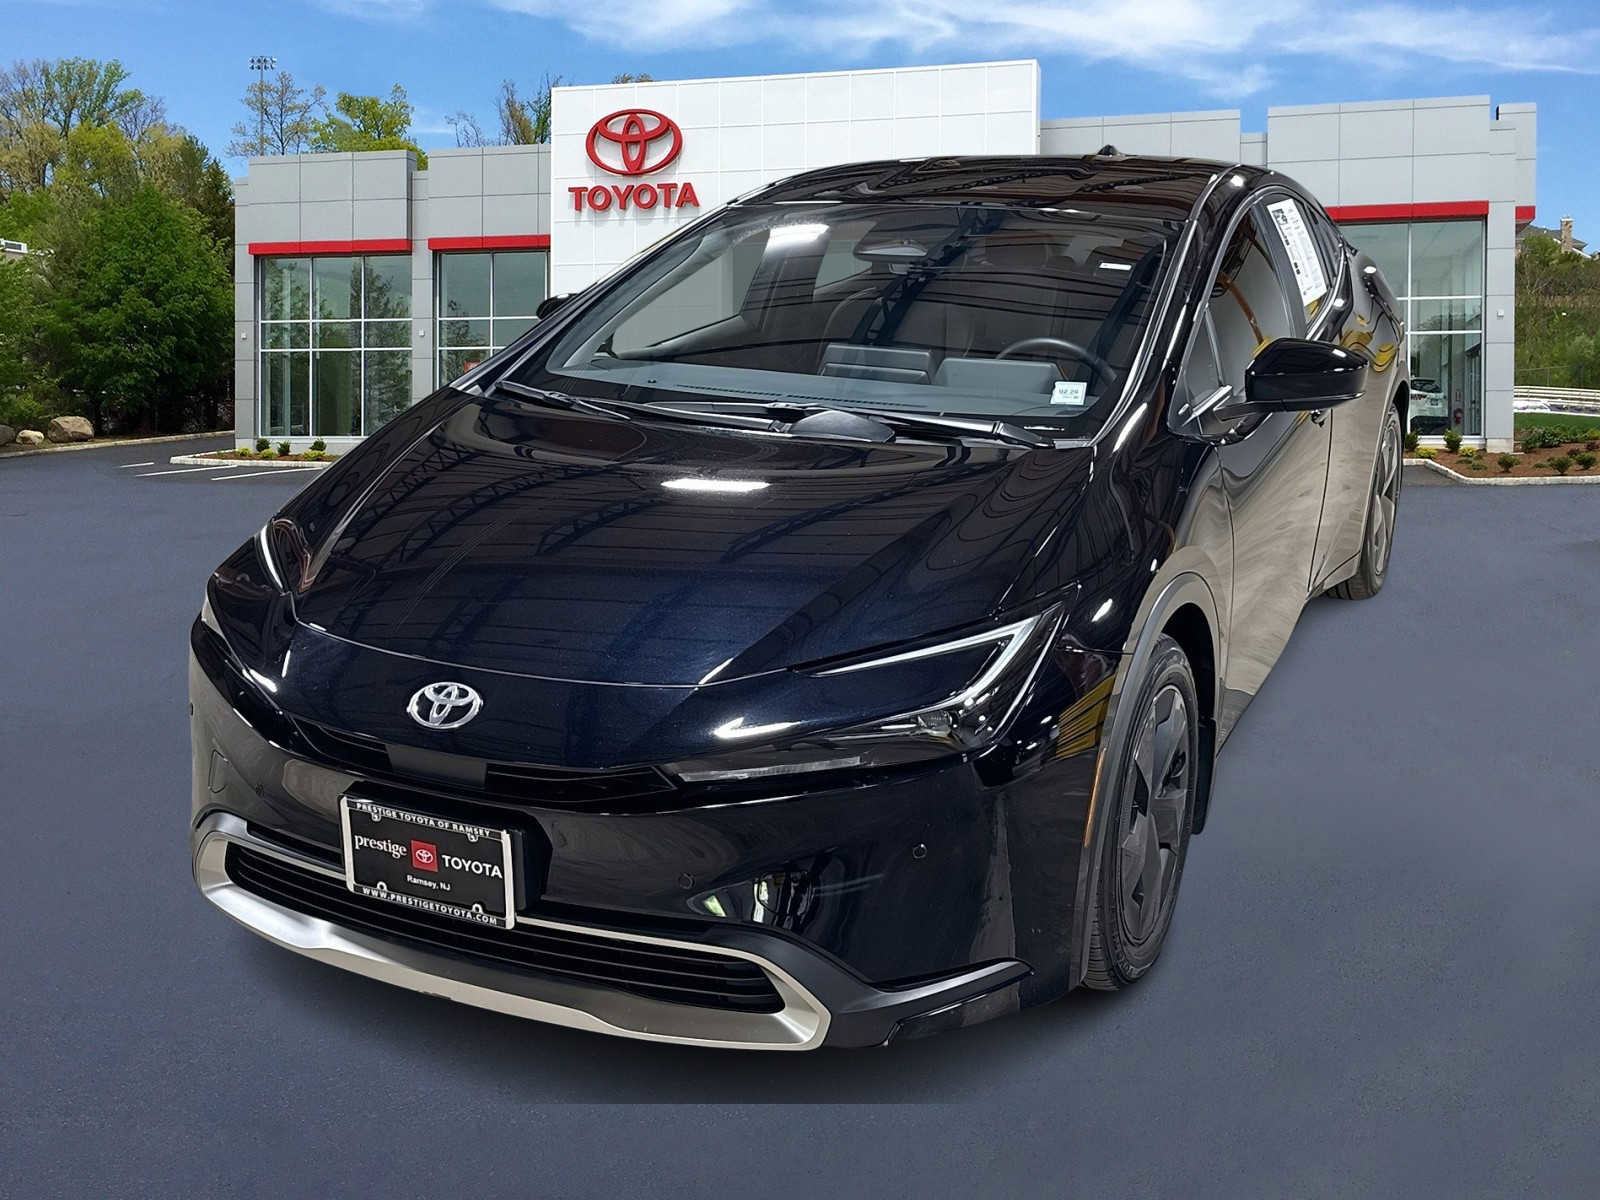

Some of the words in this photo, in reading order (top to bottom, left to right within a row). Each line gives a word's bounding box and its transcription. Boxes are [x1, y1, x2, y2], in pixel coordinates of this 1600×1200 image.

[568, 182, 700, 211] TOYOTA
[356, 802, 397, 819] PRESTIGE
[399, 812, 435, 827] TOYOTA
[438, 820, 450, 829] OF
[452, 823, 491, 837] RAMSEY
[354, 834, 408, 859] prestige
[441, 854, 503, 879] TOYOTA
[406, 874, 439, 890] Ramsey,
[440, 881, 451, 891] NJ
[362, 887, 497, 926] WWW.PRESTIGETOYOTA.COM
